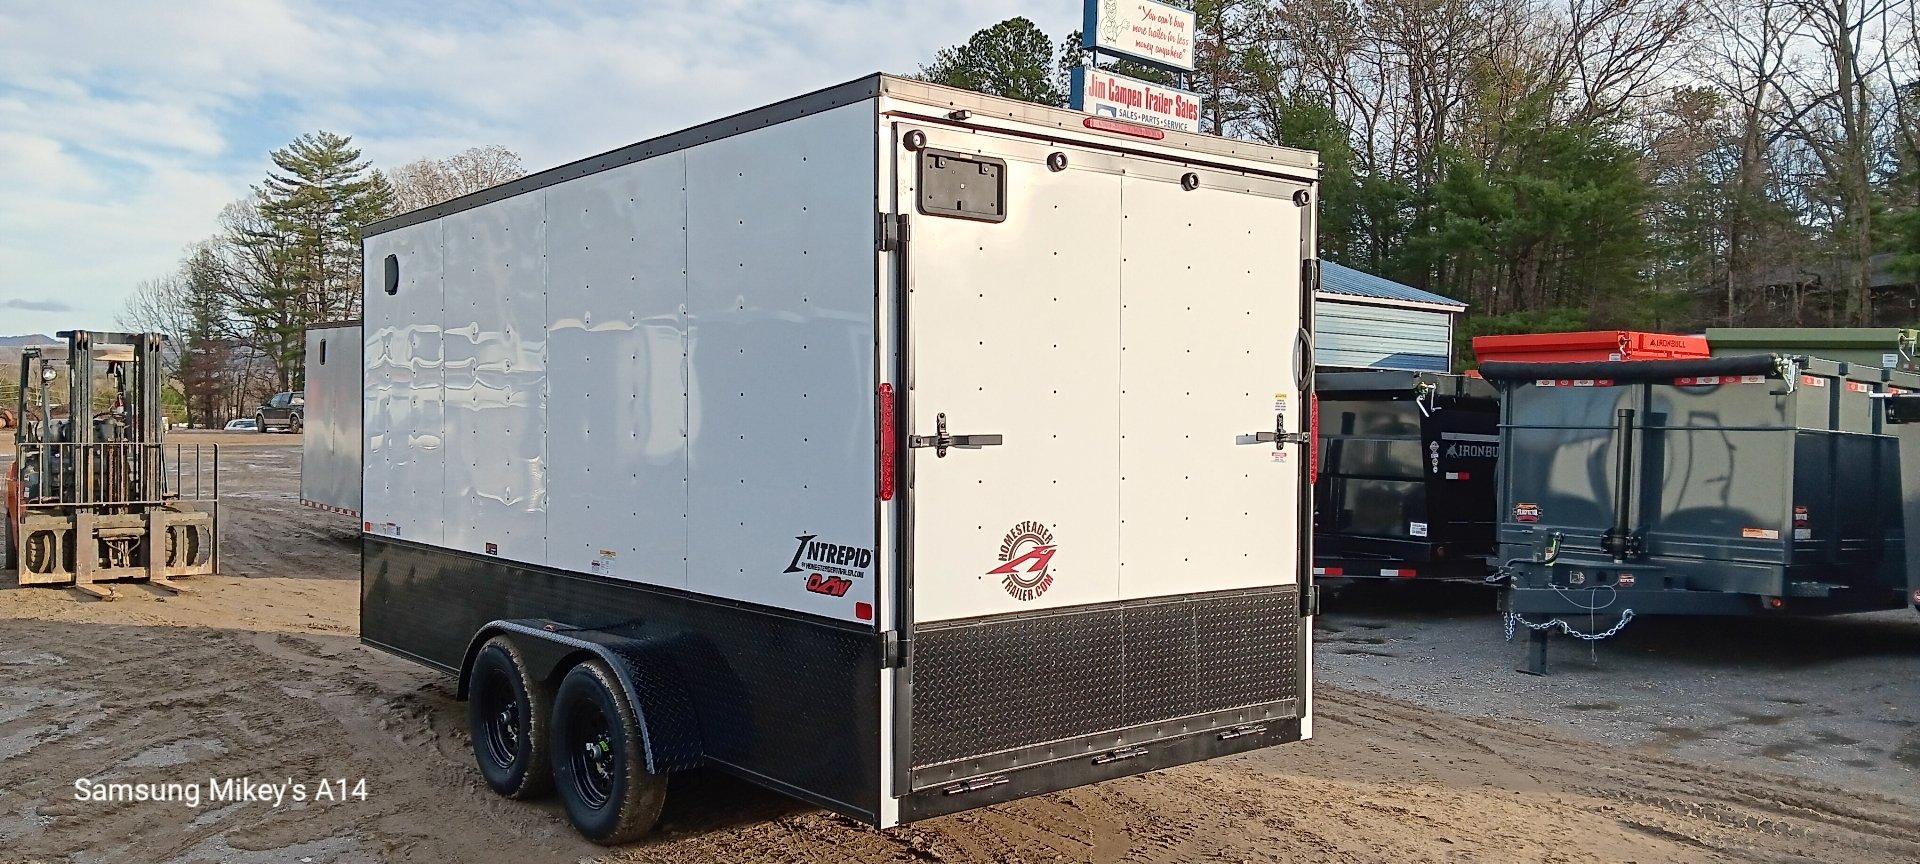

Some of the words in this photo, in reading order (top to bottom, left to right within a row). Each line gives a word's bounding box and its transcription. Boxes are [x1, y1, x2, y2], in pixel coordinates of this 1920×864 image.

[1158, 13, 1172, 26] can't
[1174, 16, 1184, 32] buy
[1132, 25, 1147, 36] more
[1148, 27, 1166, 40] trailer
[1168, 31, 1176, 42] for
[1177, 33, 1189, 46] less
[1135, 40, 1153, 55] money
[1088, 74, 1106, 99] Jim
[1109, 78, 1142, 108] Campen
[1145, 87, 1173, 115] Trailer
[1175, 95, 1198, 120] Sales
[1119, 108, 1138, 120] SALES
[1141, 114, 1160, 126] PARTS
[1164, 118, 1188, 131] SERVICE
[1458, 444, 1499, 458] IRONBU
[998, 520, 1054, 562] HOMESTEADER
[783, 534, 872, 574] INTREPID
